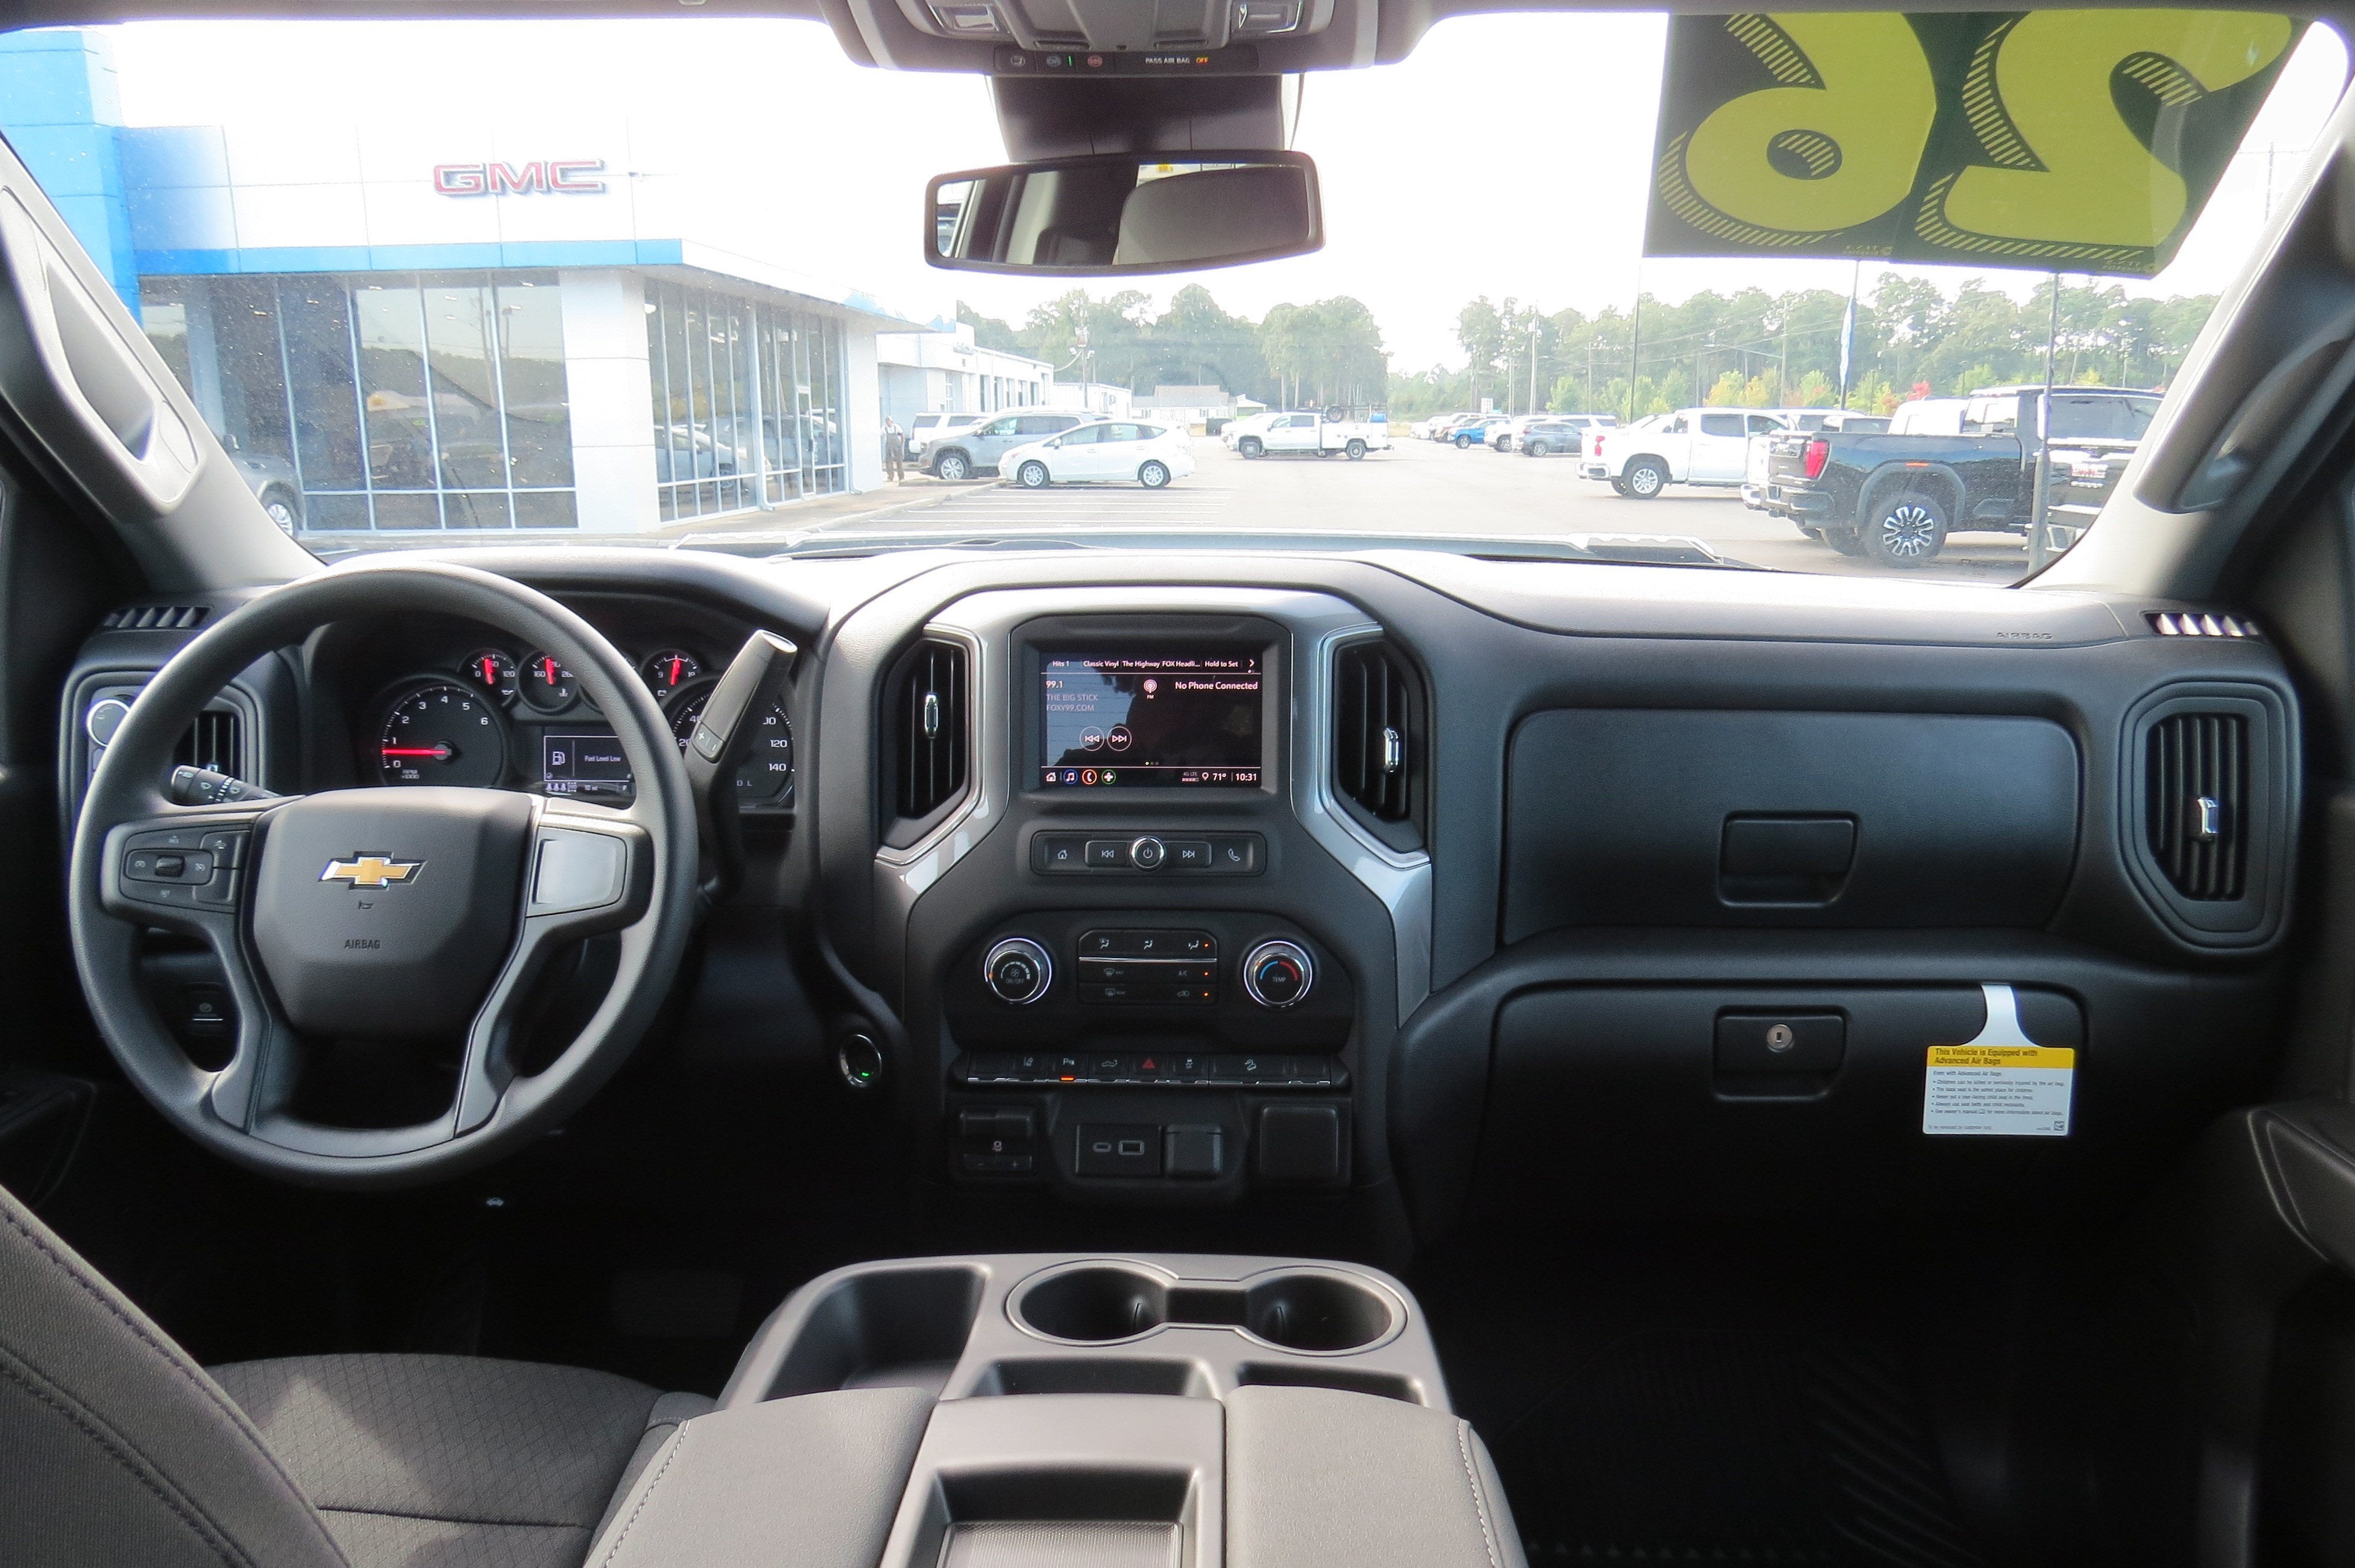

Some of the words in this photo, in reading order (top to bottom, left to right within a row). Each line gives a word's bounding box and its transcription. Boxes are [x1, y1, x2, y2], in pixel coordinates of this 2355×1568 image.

[434, 159, 606, 195] GMC
[1135, 660, 1160, 669] Highway
[1175, 682, 1187, 690] No
[1188, 682, 1213, 690] Phone
[1215, 682, 1258, 690] Connected
[419, 702, 427, 710] 3
[462, 702, 470, 710] 5
[402, 716, 410, 724] 2
[480, 717, 488, 725] 6
[770, 739, 787, 748] 120
[393, 760, 401, 768] 0
[1235, 773, 1257, 781] 10:31
[344, 939, 380, 949] AIRBAG
[1988, 1049, 2020, 1057] Equipped
[1983, 1057, 2001, 1065] Bags
